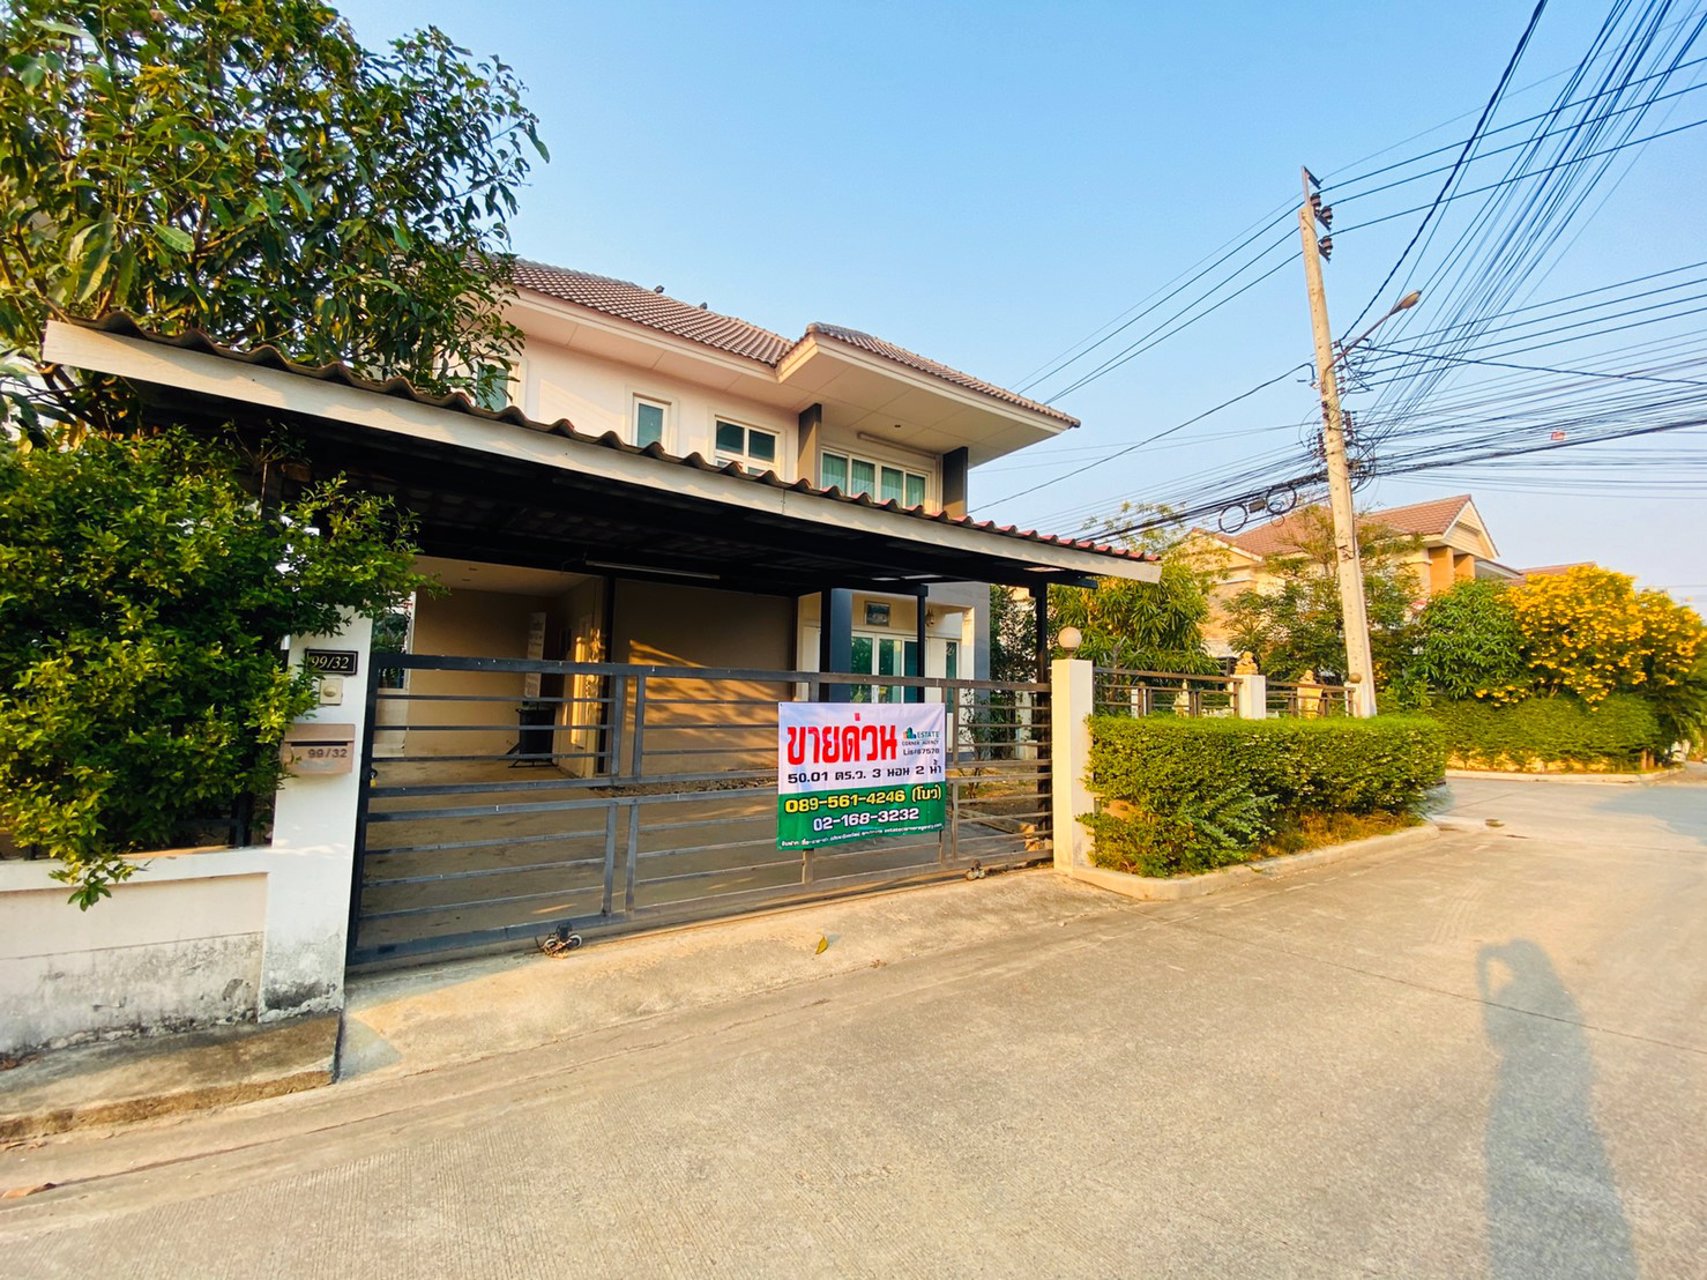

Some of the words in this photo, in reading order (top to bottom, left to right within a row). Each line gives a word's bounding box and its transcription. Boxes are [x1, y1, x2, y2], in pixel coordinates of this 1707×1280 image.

[311, 655, 349, 669] 99/32
[787, 713, 897, 764] ขายด่วน
[309, 748, 347, 758] 99/32
[788, 772, 828, 783] 50.01
[835, 771, 866, 780] ตร.ว.
[872, 769, 881, 778] 3
[887, 767, 910, 777] นอน
[916, 766, 925, 774] 2
[930, 759, 942, 774] น้ำ
[785, 790, 906, 812] 089-561-4246
[814, 808, 919, 831] 02-168-3232
